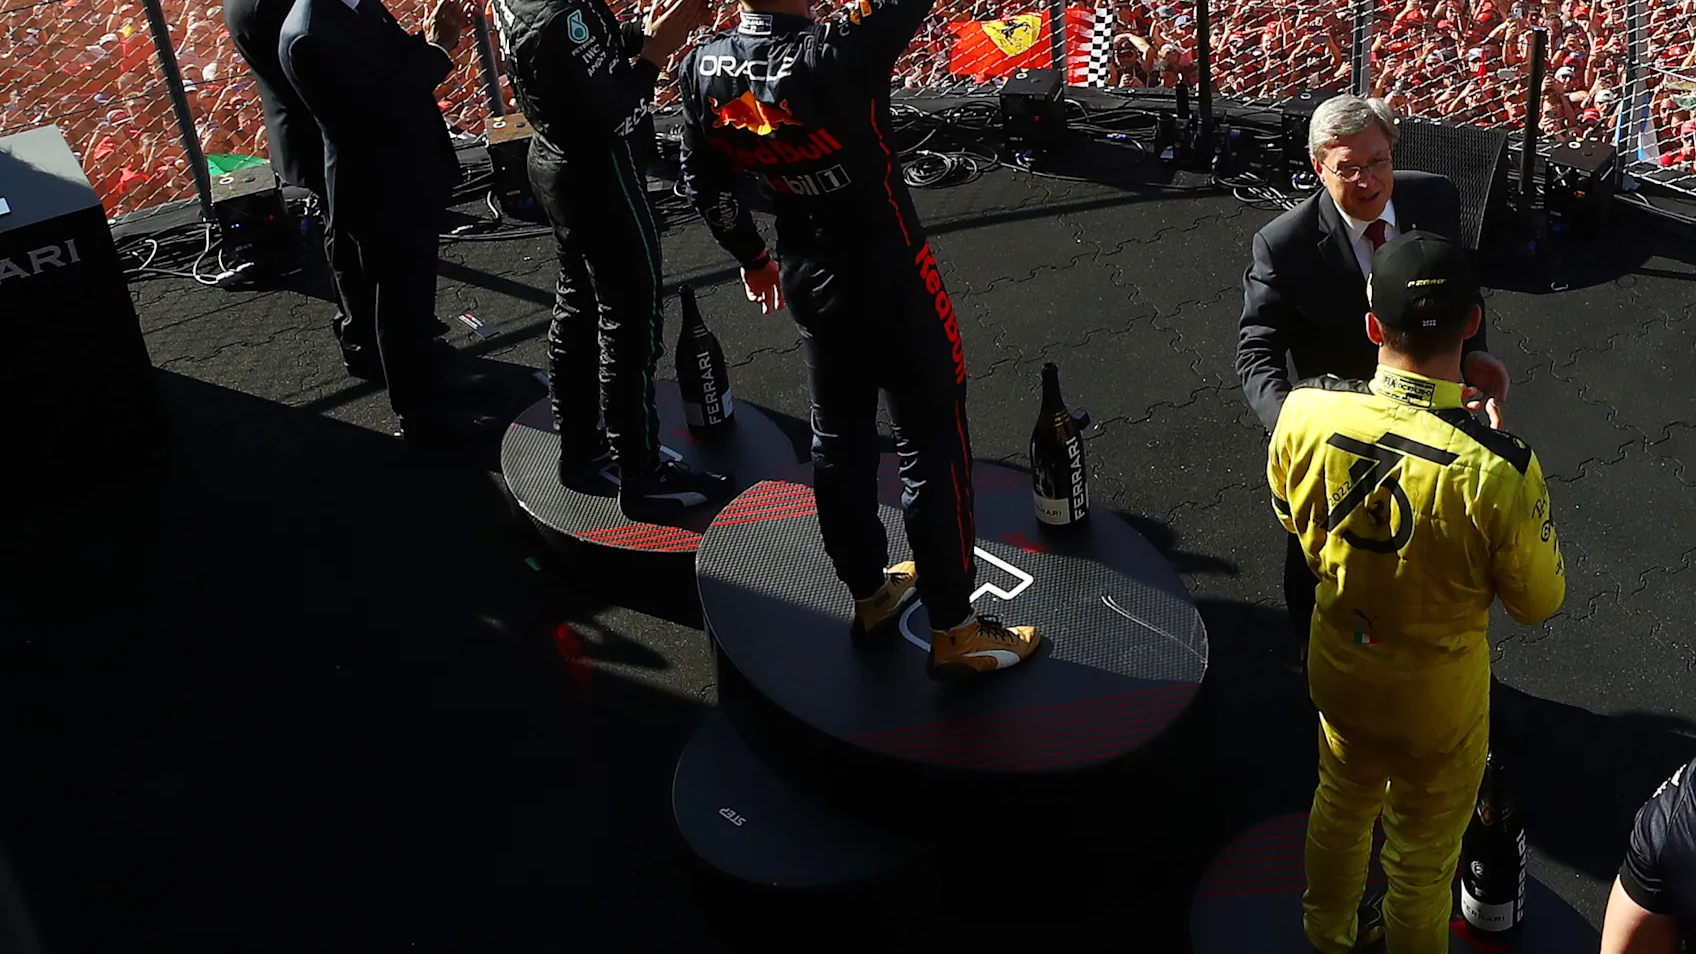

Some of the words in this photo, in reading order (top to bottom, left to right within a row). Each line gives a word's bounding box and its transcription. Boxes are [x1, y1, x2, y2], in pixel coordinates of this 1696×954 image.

[700, 54, 795, 82] ORACLE
[767, 127, 843, 165] Bull
[696, 350, 722, 426] FERRARI
[1066, 435, 1086, 521] FERRARI
[719, 807, 747, 827] STEP
[1515, 827, 1527, 923] FERRARI
